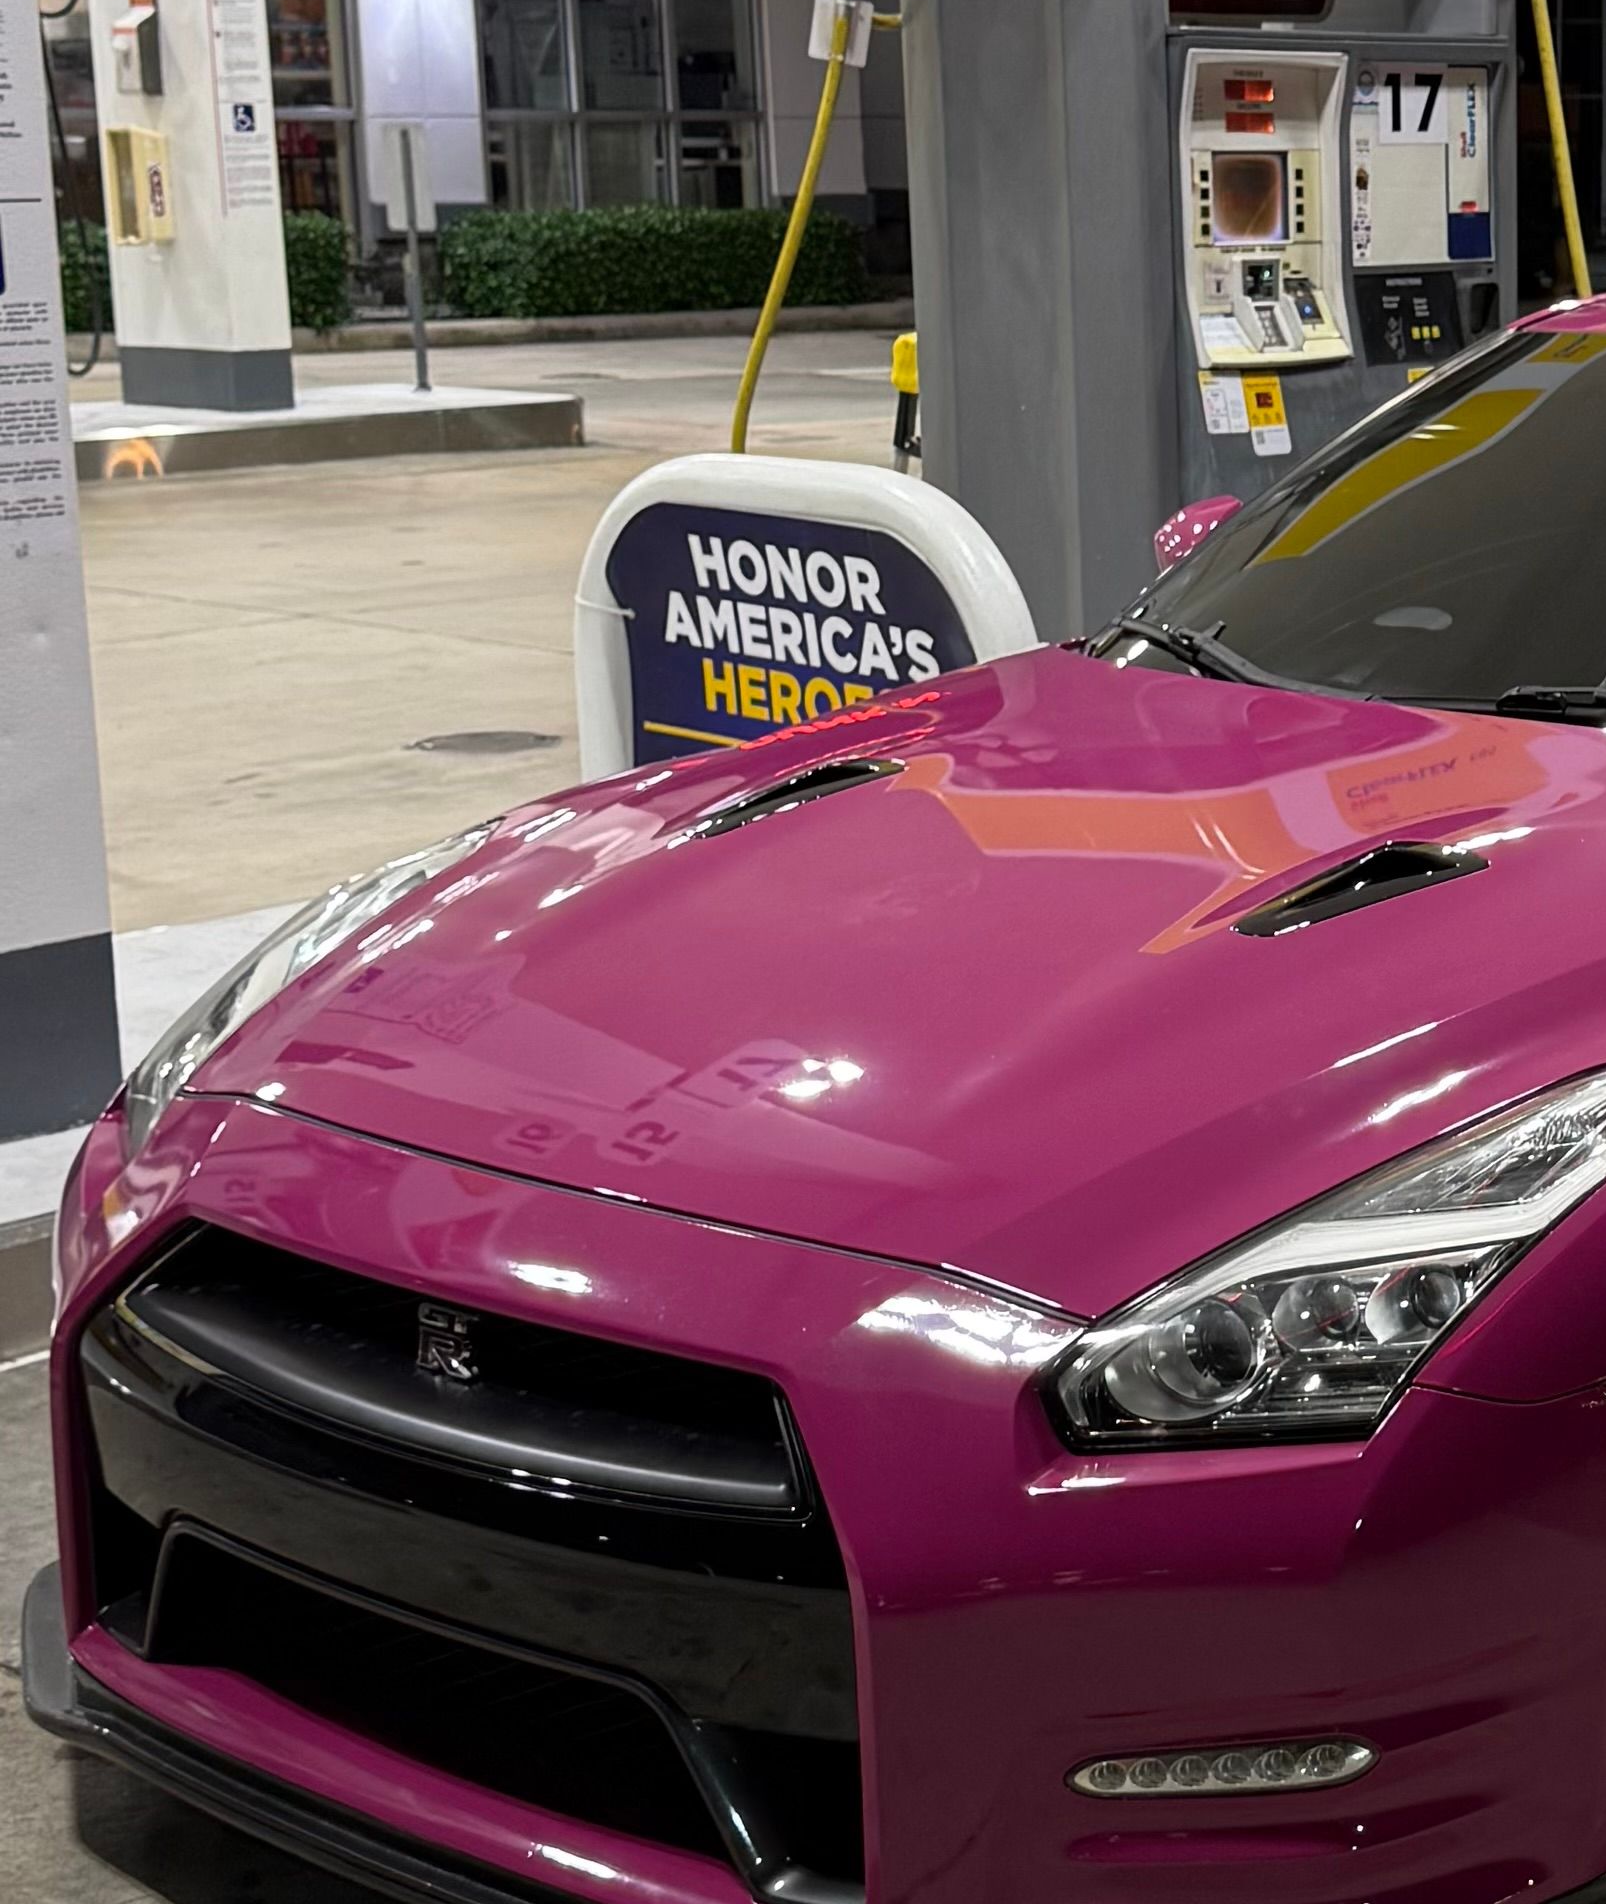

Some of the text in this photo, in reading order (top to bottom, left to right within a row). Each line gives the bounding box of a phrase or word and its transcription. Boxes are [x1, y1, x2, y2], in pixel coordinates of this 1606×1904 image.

[1384, 72, 1444, 133] 17
[687, 533, 887, 615] HONOR
[665, 590, 941, 684] AMERICA'S
[702, 657, 885, 726] HERO
